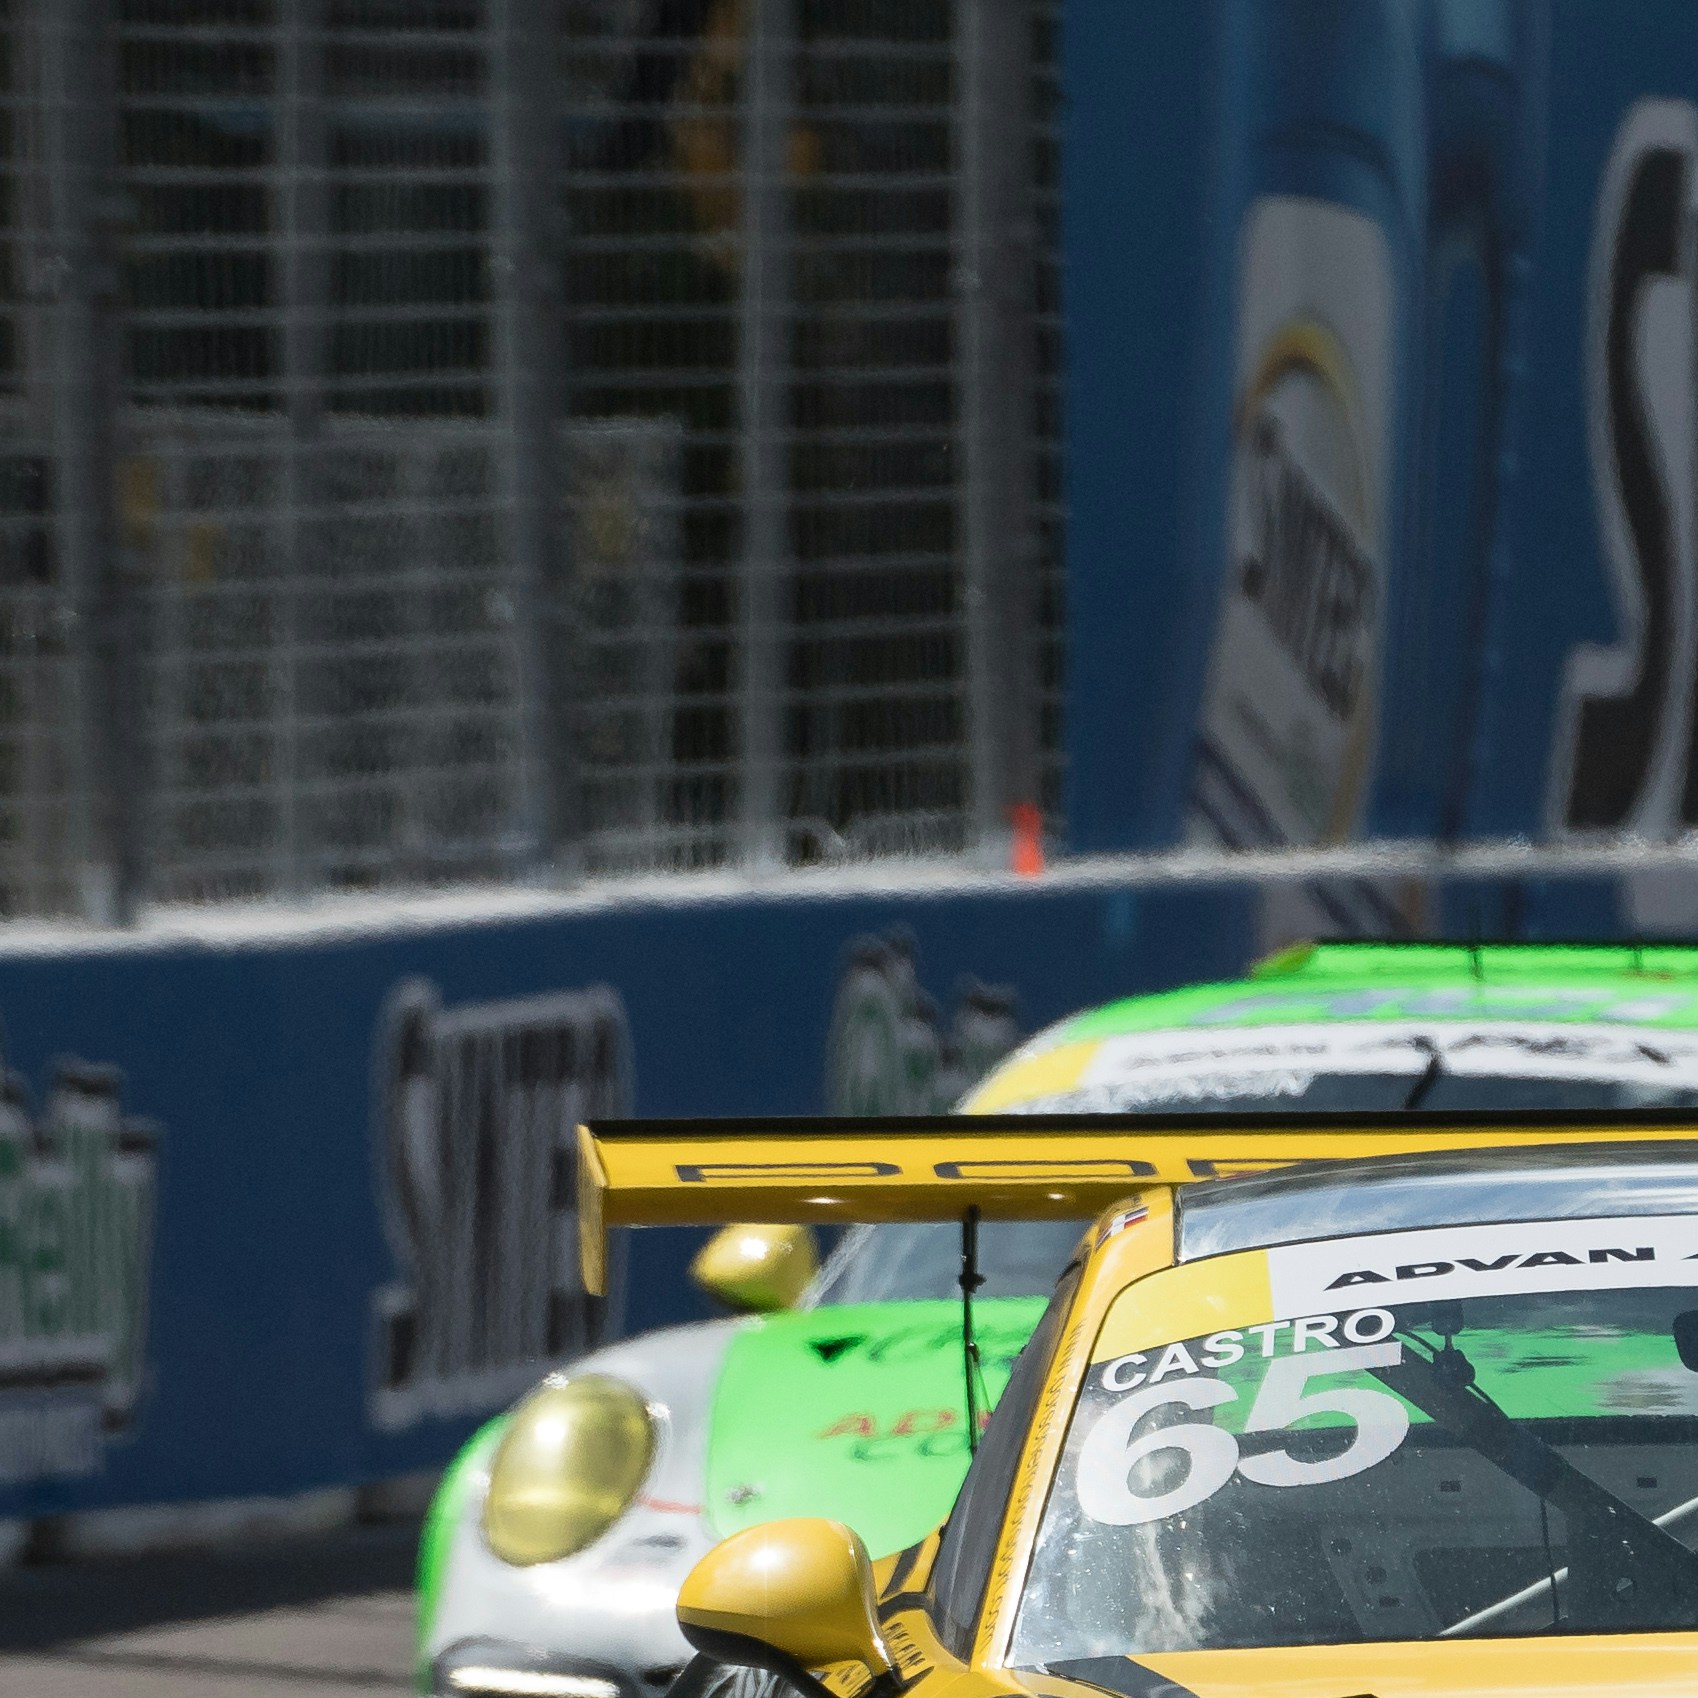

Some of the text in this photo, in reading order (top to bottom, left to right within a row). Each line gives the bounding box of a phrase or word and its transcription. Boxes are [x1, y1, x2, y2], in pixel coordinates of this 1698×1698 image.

[1323, 1247, 1656, 1292] ADVAN
[1101, 1308, 1396, 1392] CASTRO
[1077, 1377, 1409, 1525] 65
